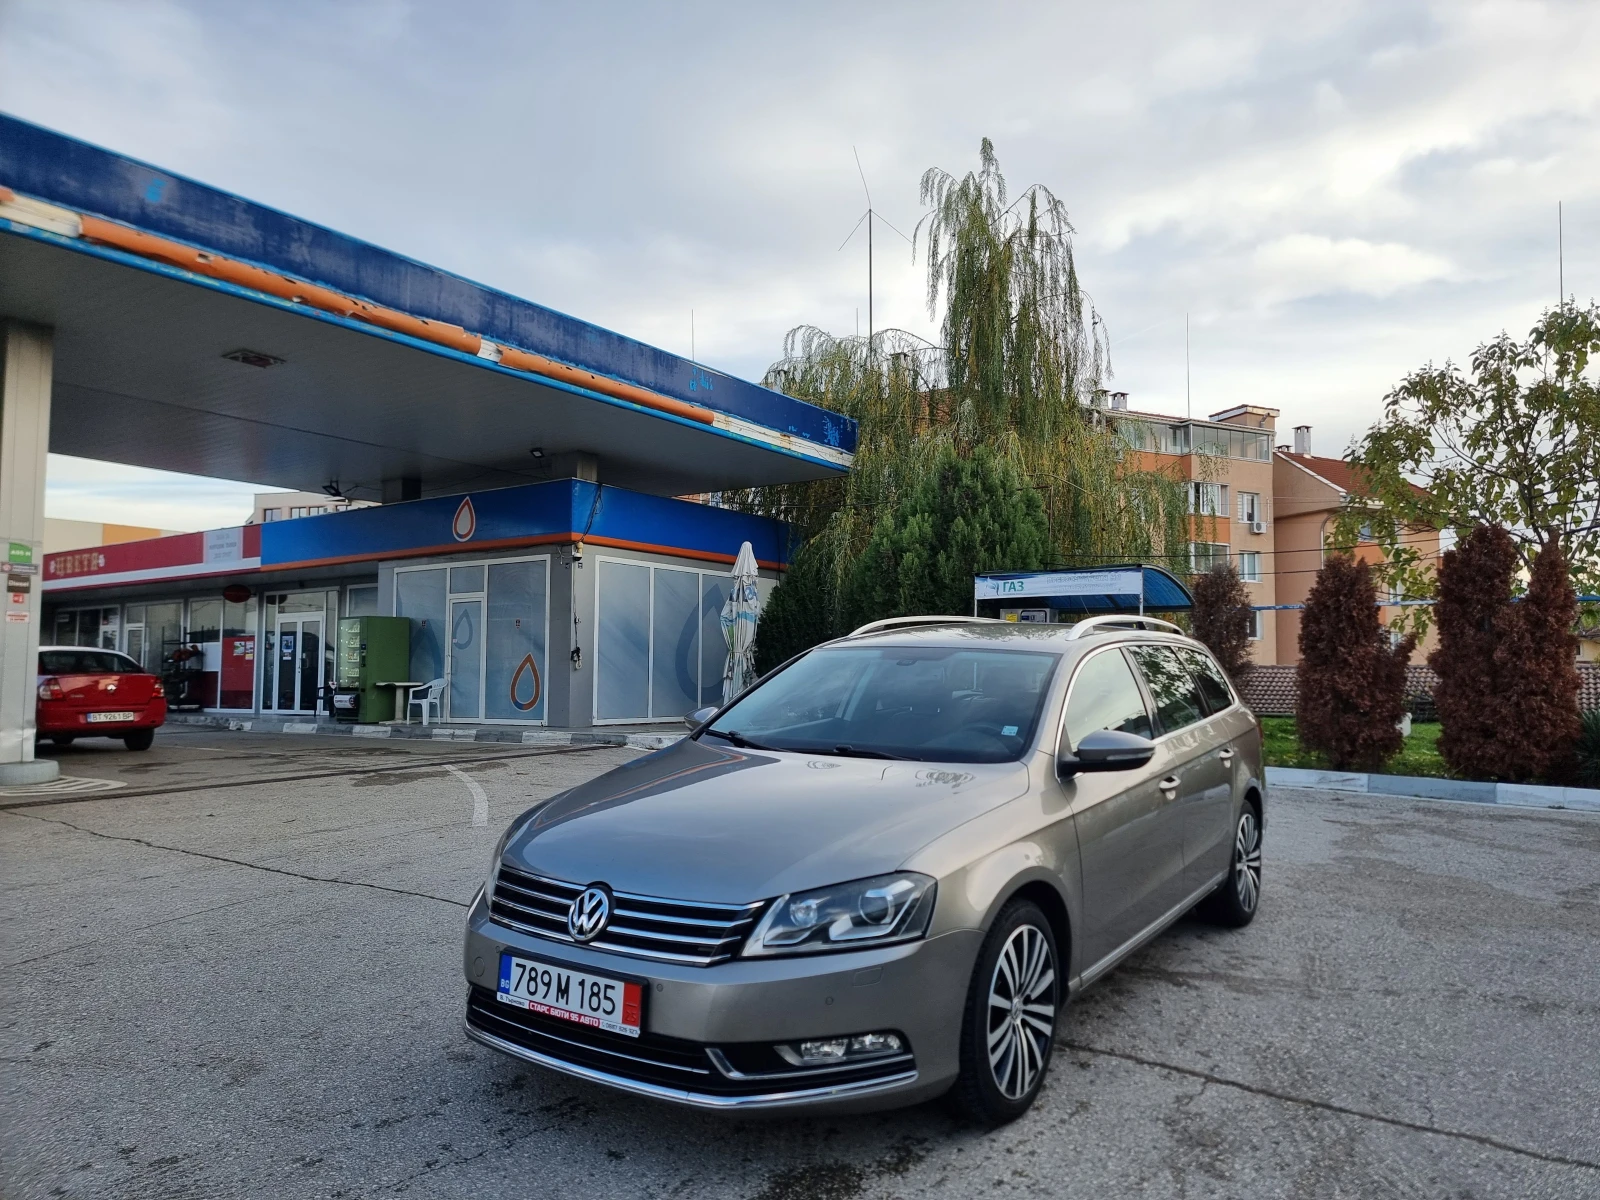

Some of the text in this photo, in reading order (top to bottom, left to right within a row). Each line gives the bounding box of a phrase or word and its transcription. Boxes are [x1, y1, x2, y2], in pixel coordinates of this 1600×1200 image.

[1003, 581, 1024, 592] ГАЗ
[500, 979, 510, 988] BG
[530, 1003, 598, 1027] СТАРС БЮТИ 95 АВТО
